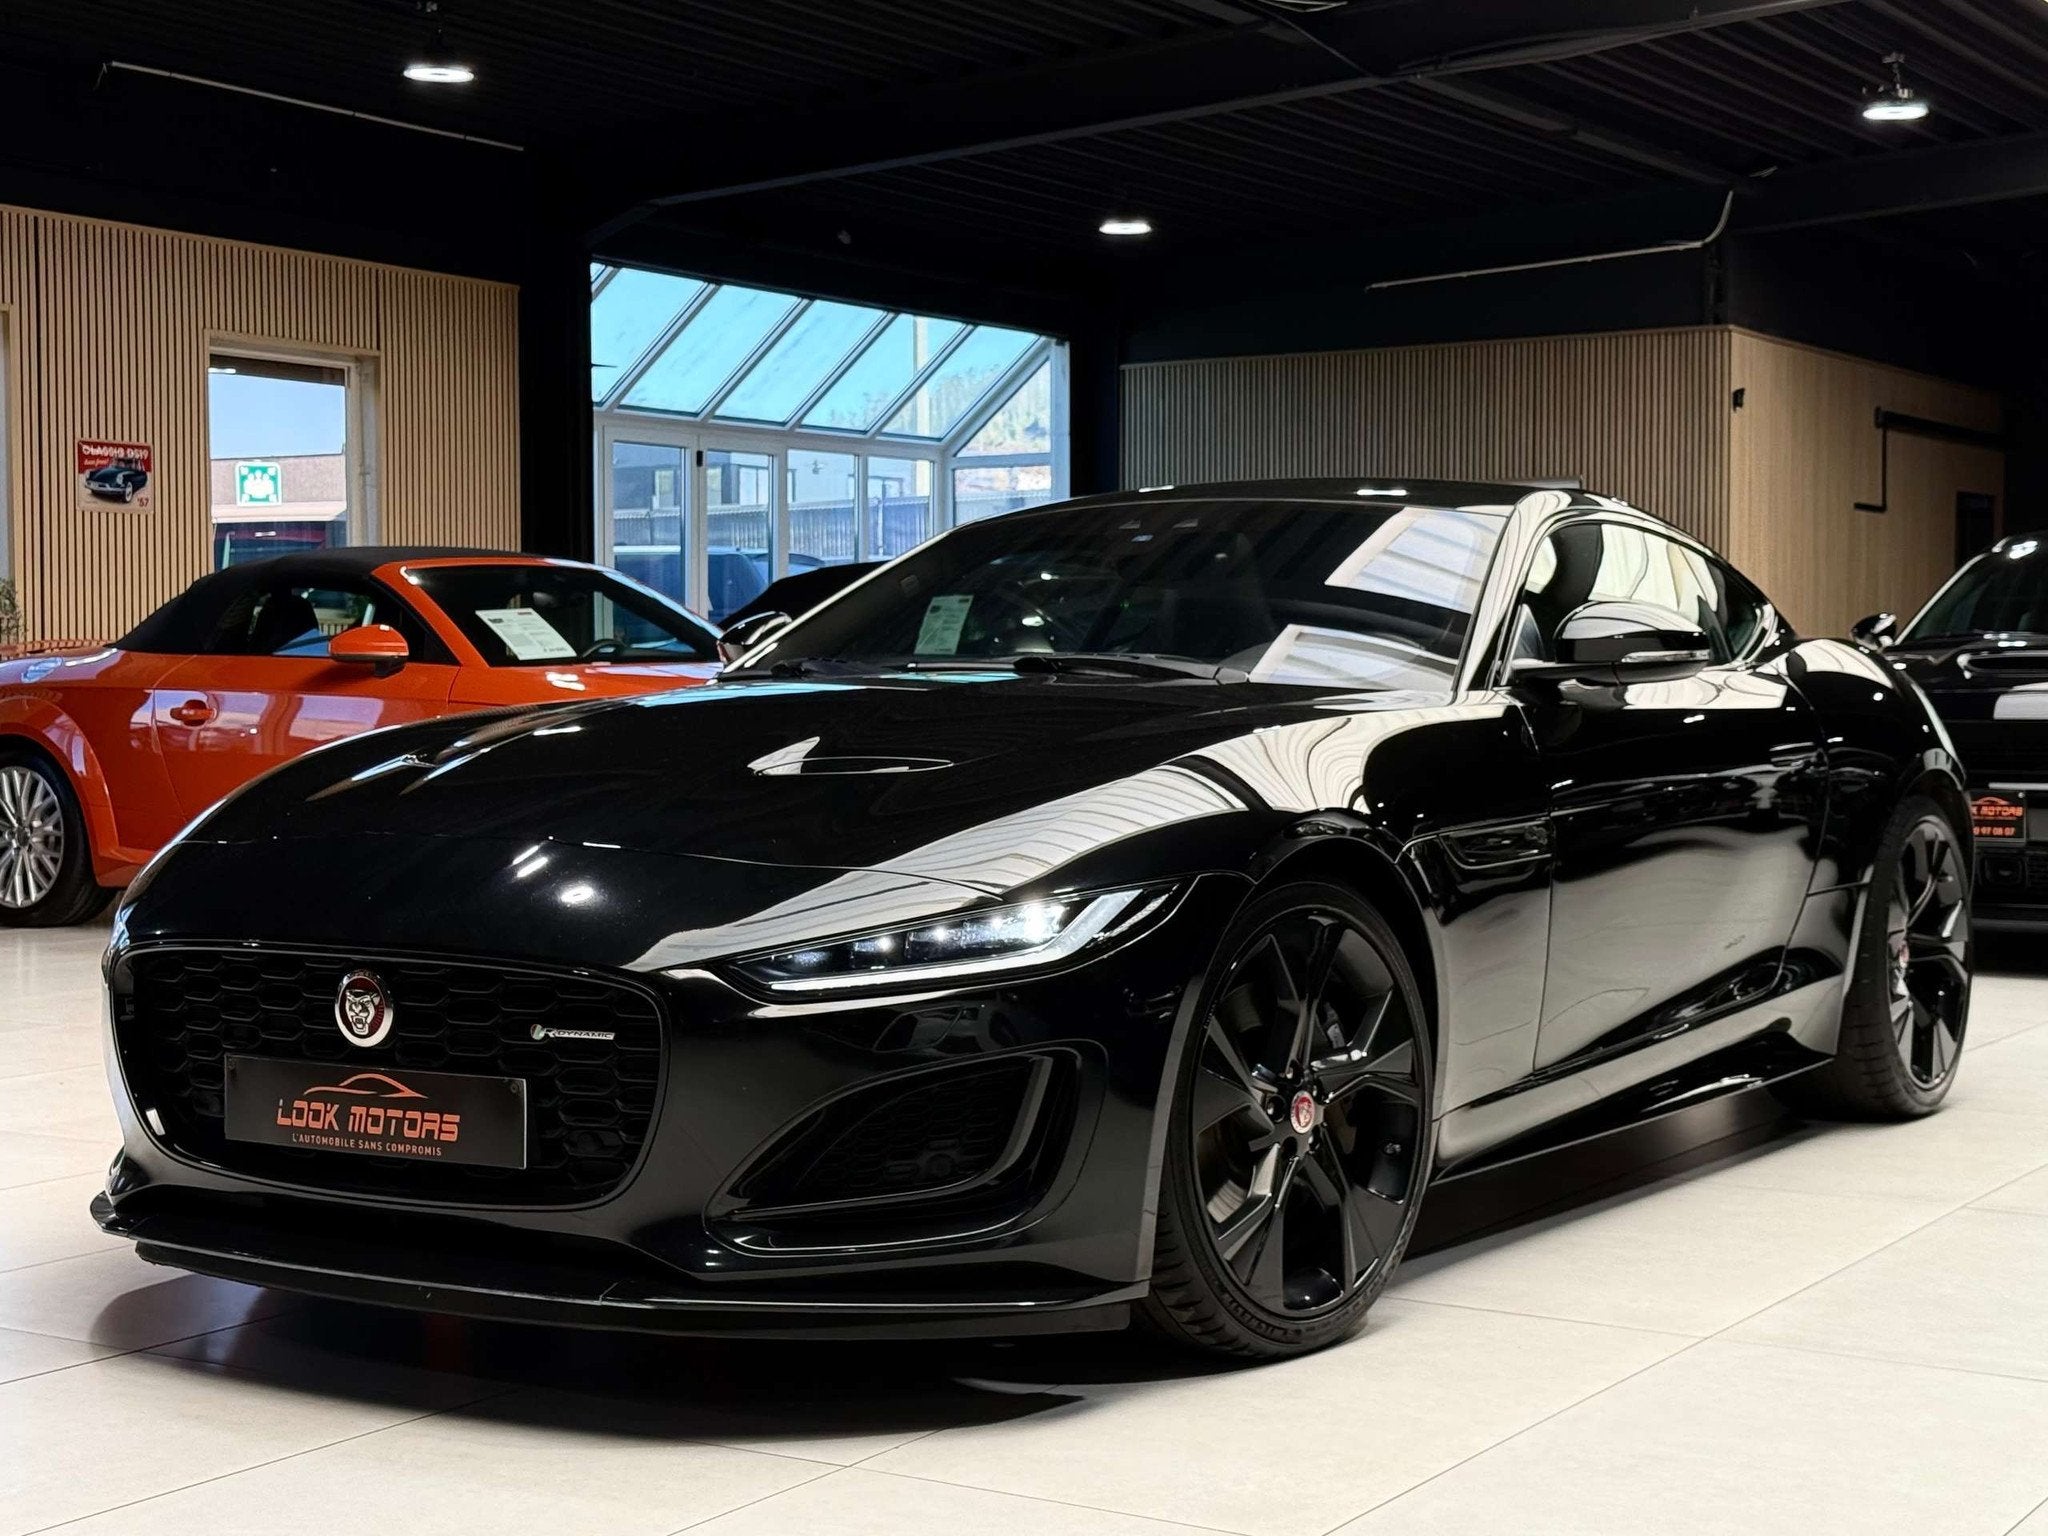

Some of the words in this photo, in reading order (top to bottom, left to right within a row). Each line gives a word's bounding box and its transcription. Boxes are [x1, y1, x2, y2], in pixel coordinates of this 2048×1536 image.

[1980, 805, 2023, 817] MOTORS
[276, 1099, 340, 1131] LOOK
[348, 1105, 461, 1142] MOTORS
[292, 1133, 356, 1148] L'AUTOMOBILE
[358, 1139, 383, 1151] SANS
[385, 1142, 442, 1156] COMPROMIS
